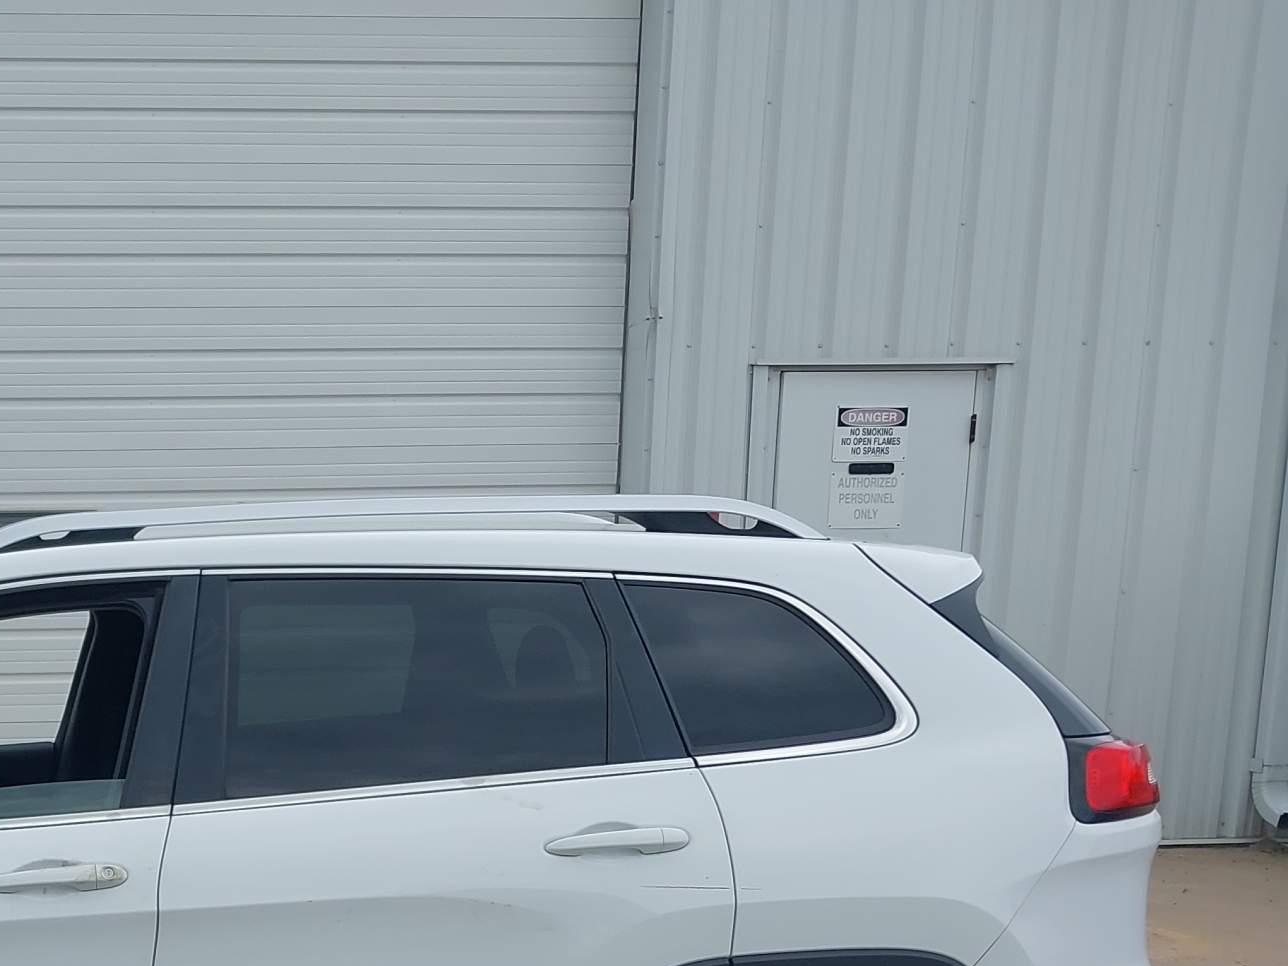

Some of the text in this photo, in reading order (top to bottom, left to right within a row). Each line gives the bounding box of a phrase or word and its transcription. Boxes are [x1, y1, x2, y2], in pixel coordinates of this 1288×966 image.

[848, 412, 898, 423] DANGER
[850, 427, 894, 437] NO SMOKING
[841, 436, 901, 446] NO OPEN FLAMES
[850, 446, 890, 455] NO SPARKS
[837, 476, 898, 489] AUTHORIZED
[838, 492, 896, 504] PERSONNEL
[853, 508, 879, 520] ONLY
